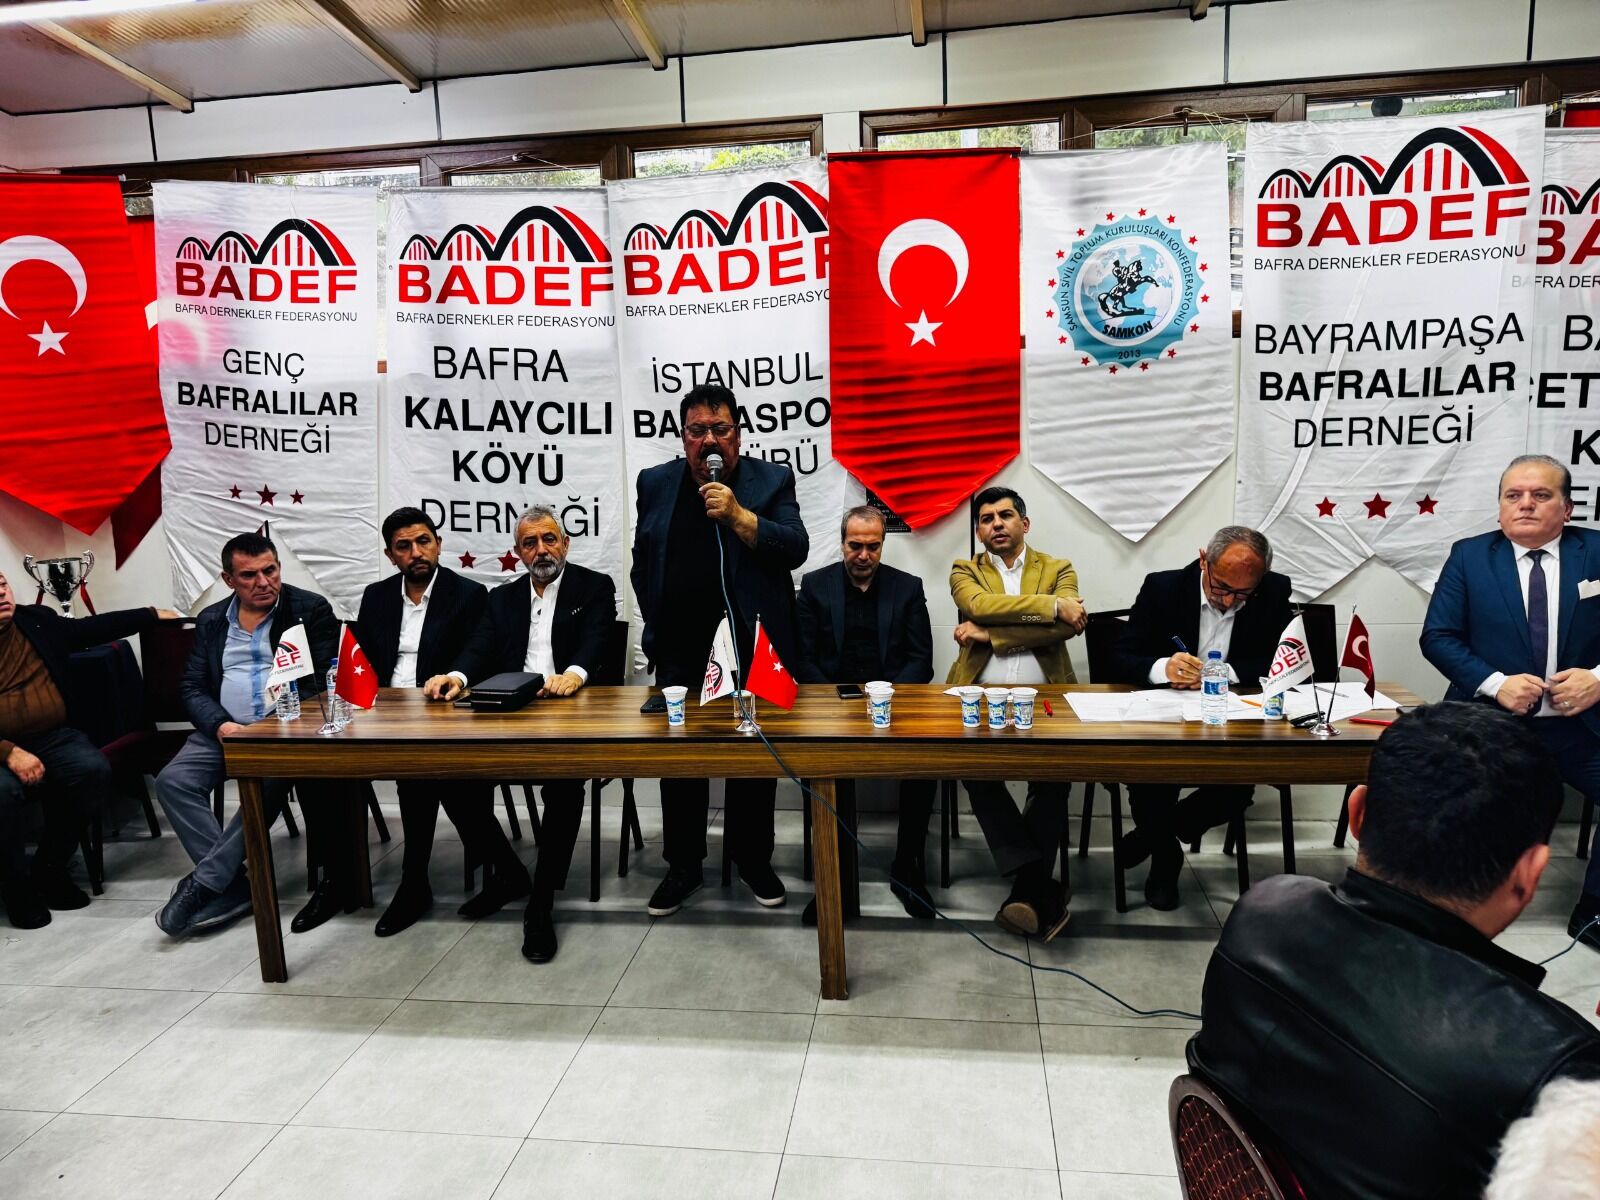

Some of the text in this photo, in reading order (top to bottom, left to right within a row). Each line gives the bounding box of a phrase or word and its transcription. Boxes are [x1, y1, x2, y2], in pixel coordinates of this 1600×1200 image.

[1257, 188, 1530, 248] BADEF
[1254, 244, 1526, 270] BAFRA DERNEKLER FEDERASYONU
[175, 261, 358, 304] BADEF
[398, 263, 614, 307] BADEF
[1061, 224, 1195, 332] SAMSUN SİVİL TOPLUM KURULUŞLARI KONFEDERASYONU
[175, 303, 358, 322] BAFRA DERNEKLER FEDERASYONU
[396, 312, 615, 328] BAFRA DERNEKLER FEDERASYONU
[626, 305, 667, 317] BAFRA
[669, 299, 750, 316] DERNEKLER
[1102, 320, 1153, 338] SAMKON
[1255, 312, 1525, 355] BAYRAMPAŞA
[1563, 314, 1600, 351] B
[222, 348, 305, 384] GENÇ
[433, 345, 569, 383] BAFRA
[652, 351, 824, 394] İSTANBUL
[1117, 349, 1141, 360] 2013
[177, 381, 358, 416] BAFRALILAR
[1259, 361, 1516, 401] BAFRALILAR
[404, 395, 613, 435] KALAYCILI
[633, 397, 831, 439] BAASPO
[1294, 405, 1474, 448] DERNEĞİ
[204, 421, 330, 454] DERNEĞİ
[452, 441, 564, 487] KÖYÜ
[421, 495, 600, 538] DERNĞİ
[1270, 646, 1306, 676] DEF
